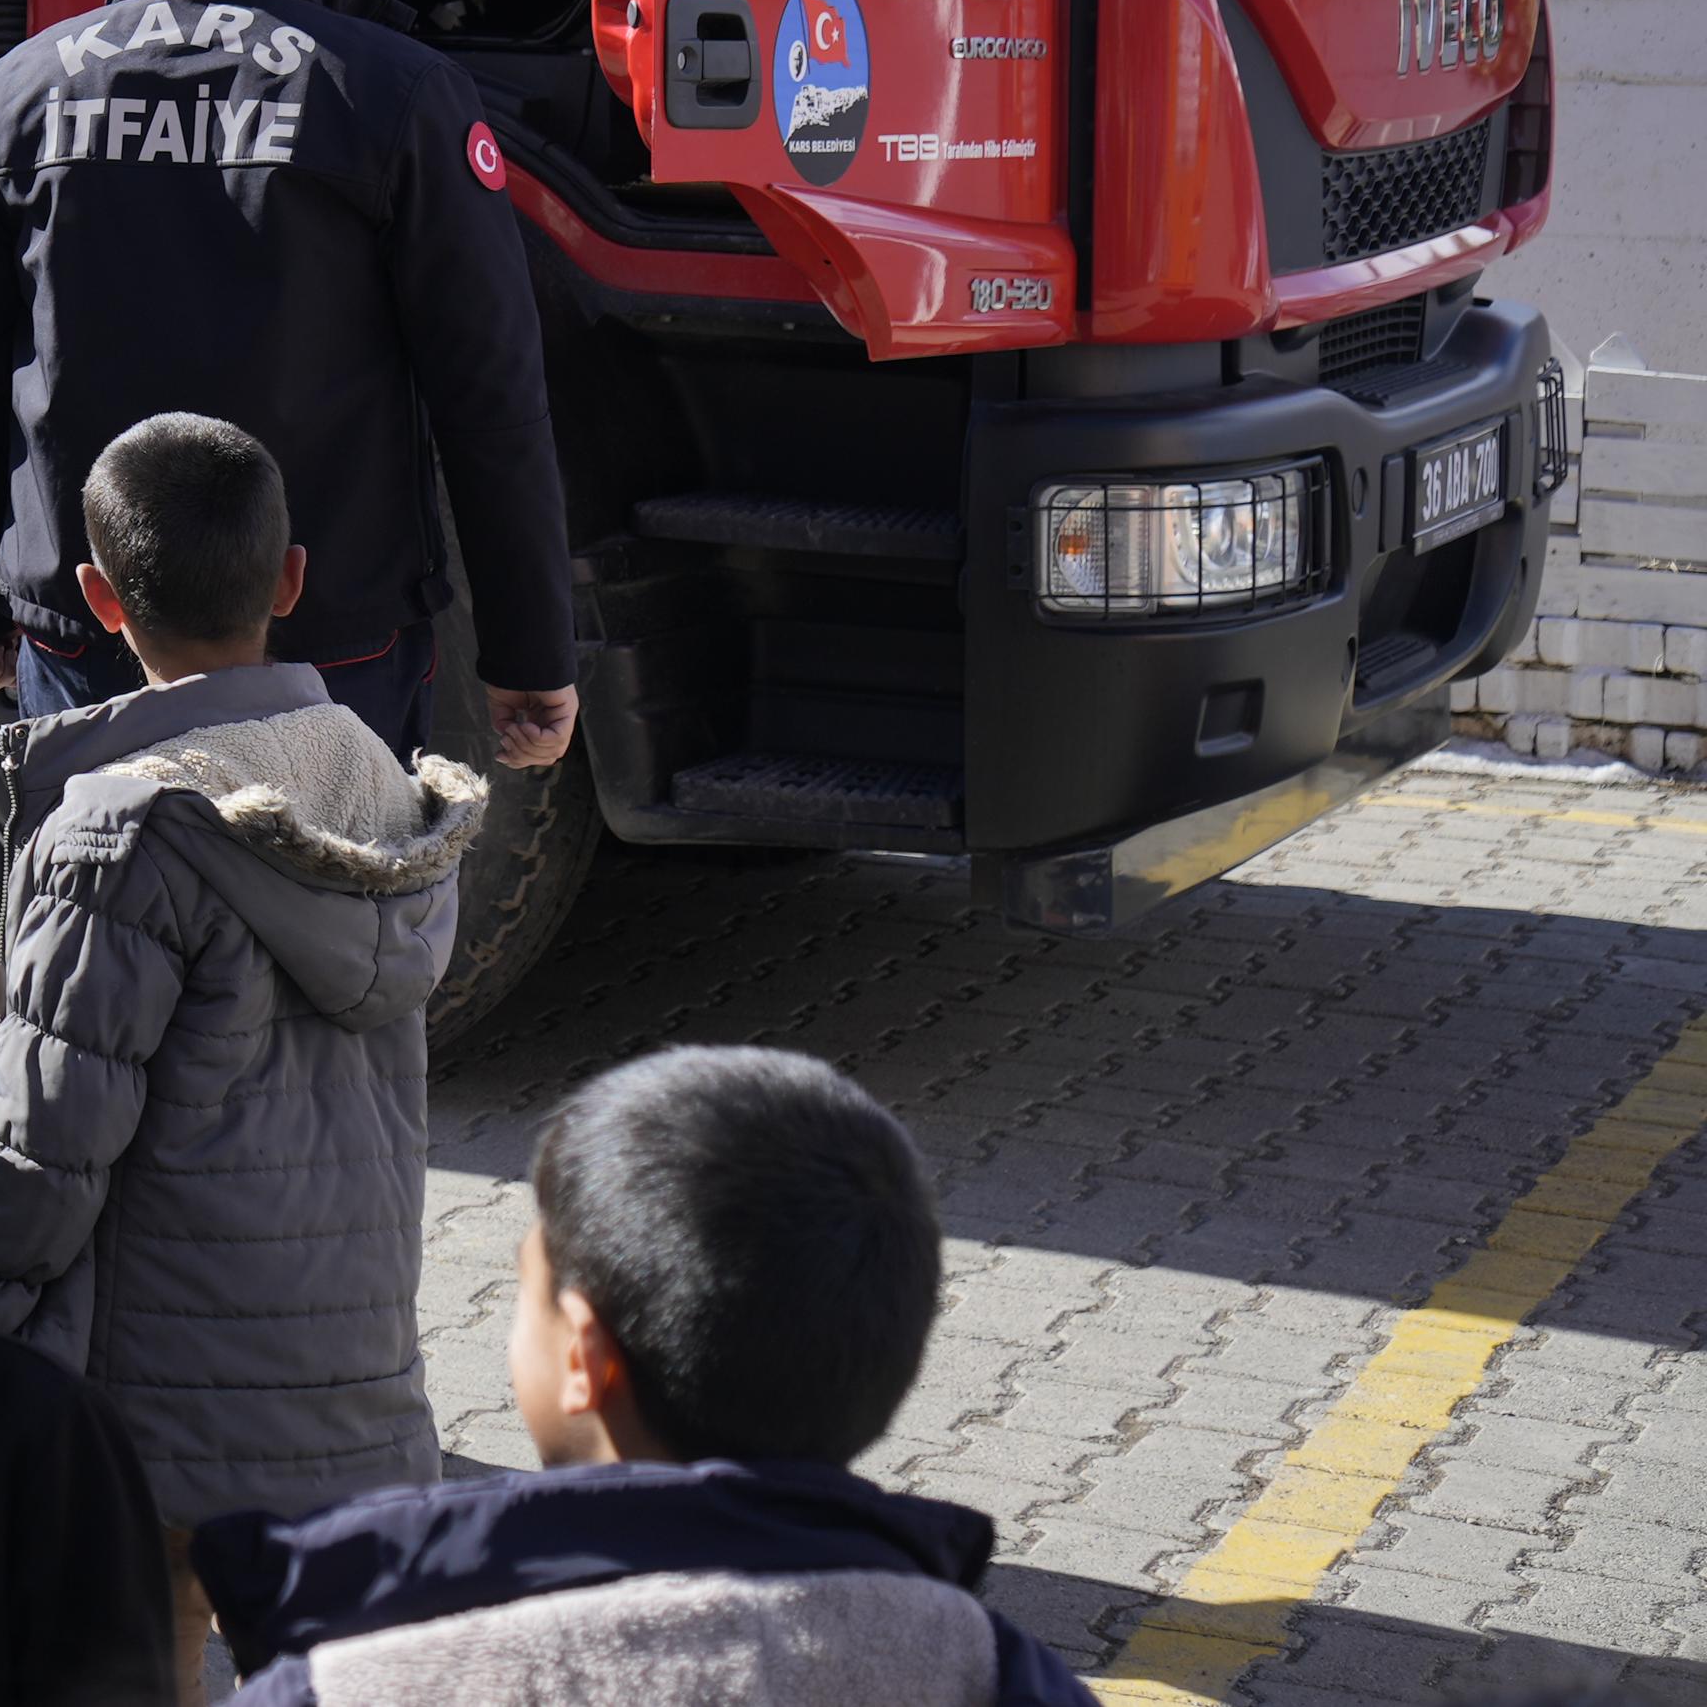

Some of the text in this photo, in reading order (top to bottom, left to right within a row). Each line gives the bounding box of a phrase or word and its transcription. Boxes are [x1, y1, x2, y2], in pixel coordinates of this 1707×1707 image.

[56, 2, 316, 77] KARS
[951, 36, 1048, 60] EUROCARGO
[43, 82, 305, 165] İTFAİYE
[788, 136, 856, 154] KARS BELEDİYESİ
[877, 133, 940, 162] TBB
[984, 140, 1001, 159] Hibe
[970, 277, 1053, 313] 180-320
[1422, 437, 1498, 522] 36 ABA 700
